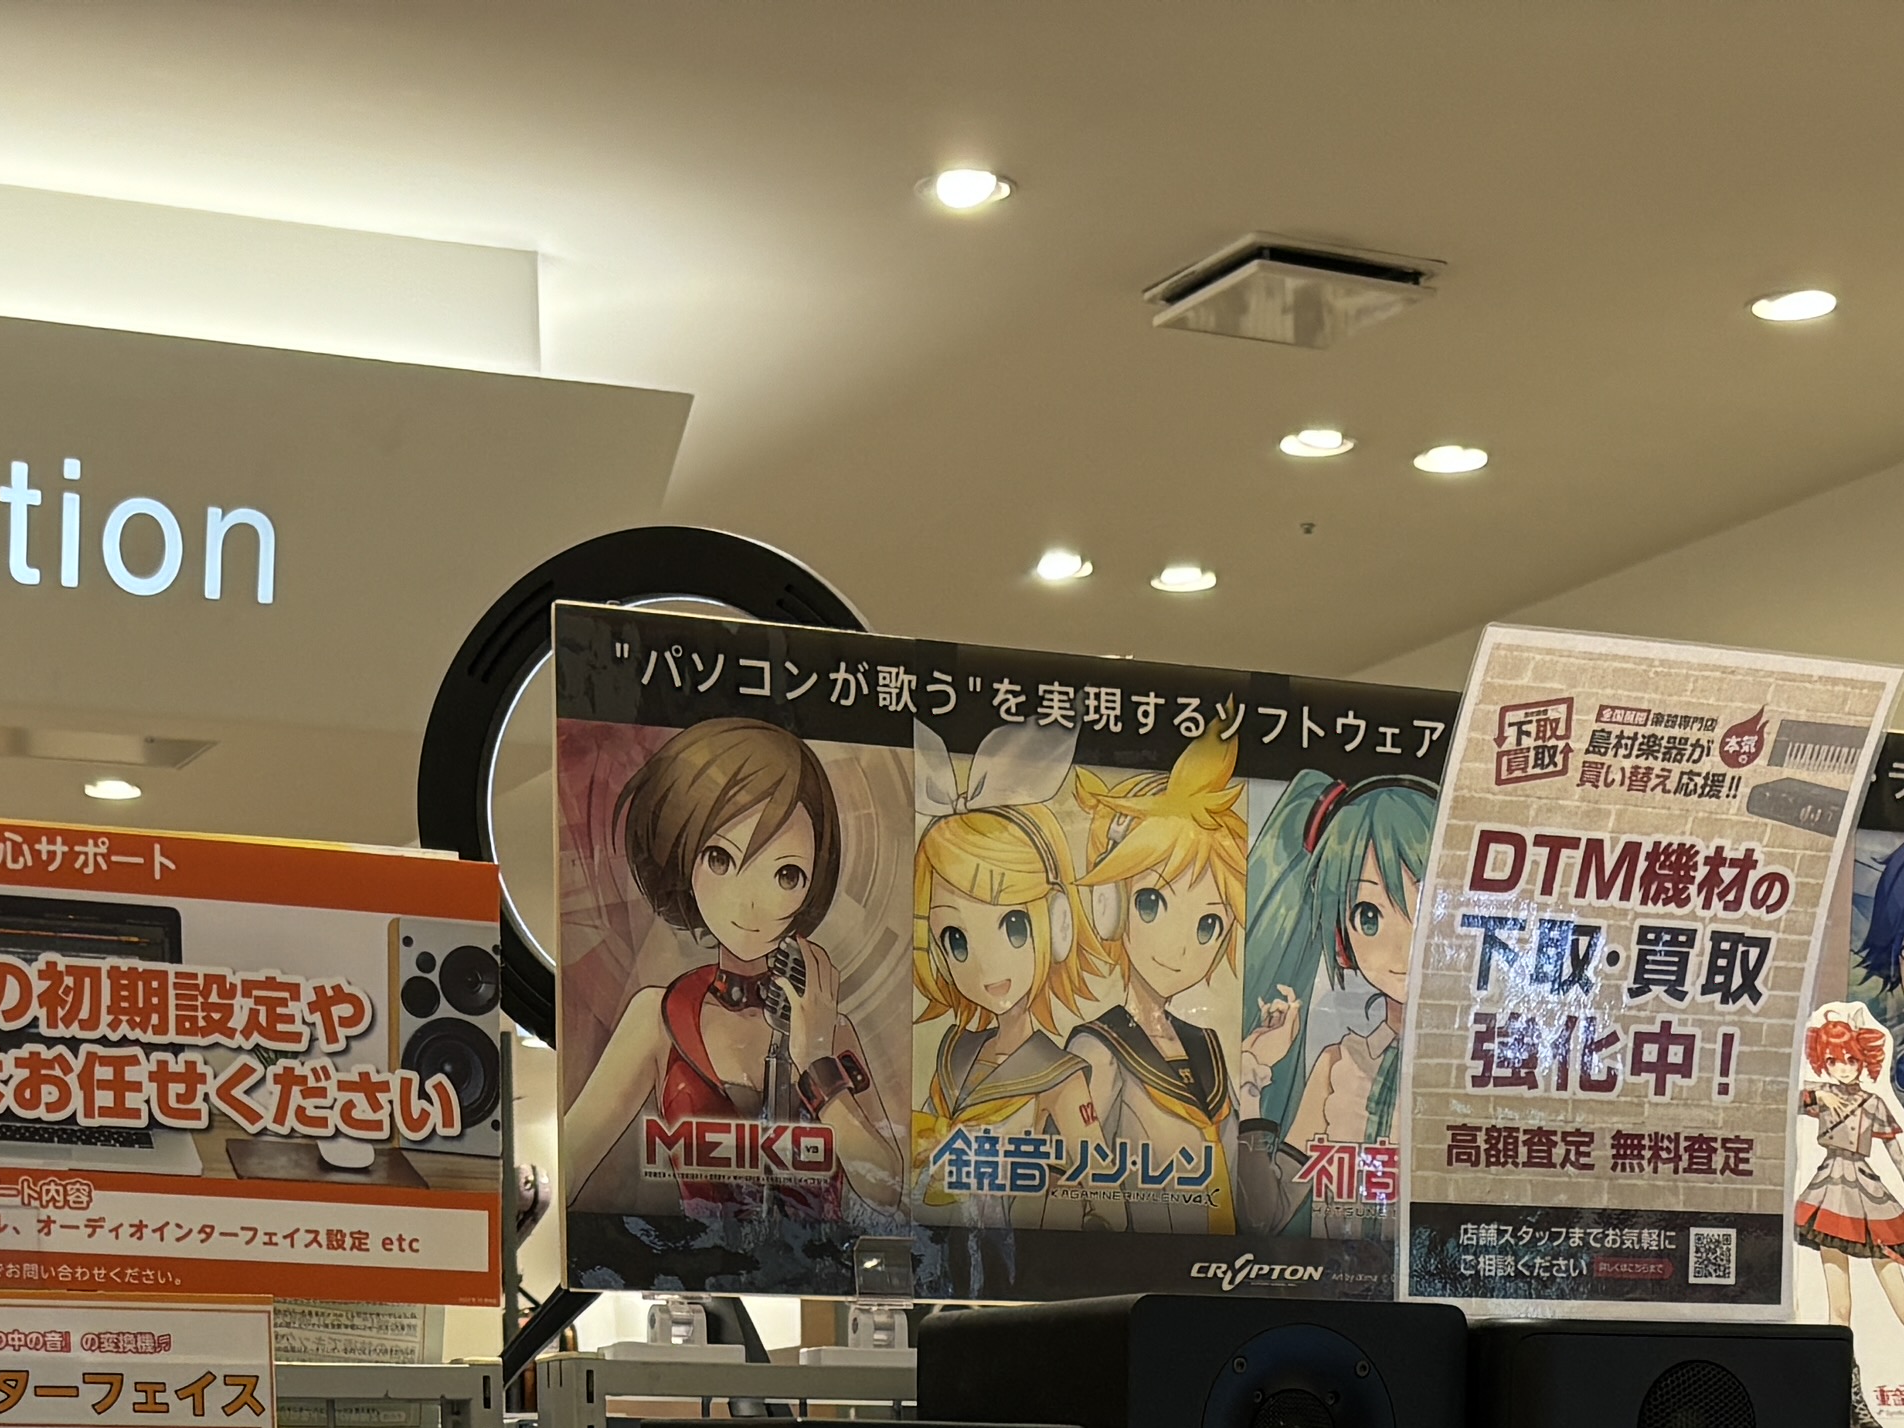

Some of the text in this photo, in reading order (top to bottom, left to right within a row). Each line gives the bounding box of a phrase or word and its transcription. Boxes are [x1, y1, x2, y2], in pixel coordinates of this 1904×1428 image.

[1584, 728, 1713, 764] 島村楽器が
[1468, 828, 1790, 916] DTM機材の
[645, 1117, 836, 1174] MEIKO
[1446, 1123, 1756, 1178] 高額査定 無料査定
[1458, 1222, 1678, 1252] 店舗スタッフまでお気軽に
[1190, 1252, 1324, 1292] CRYPTON
